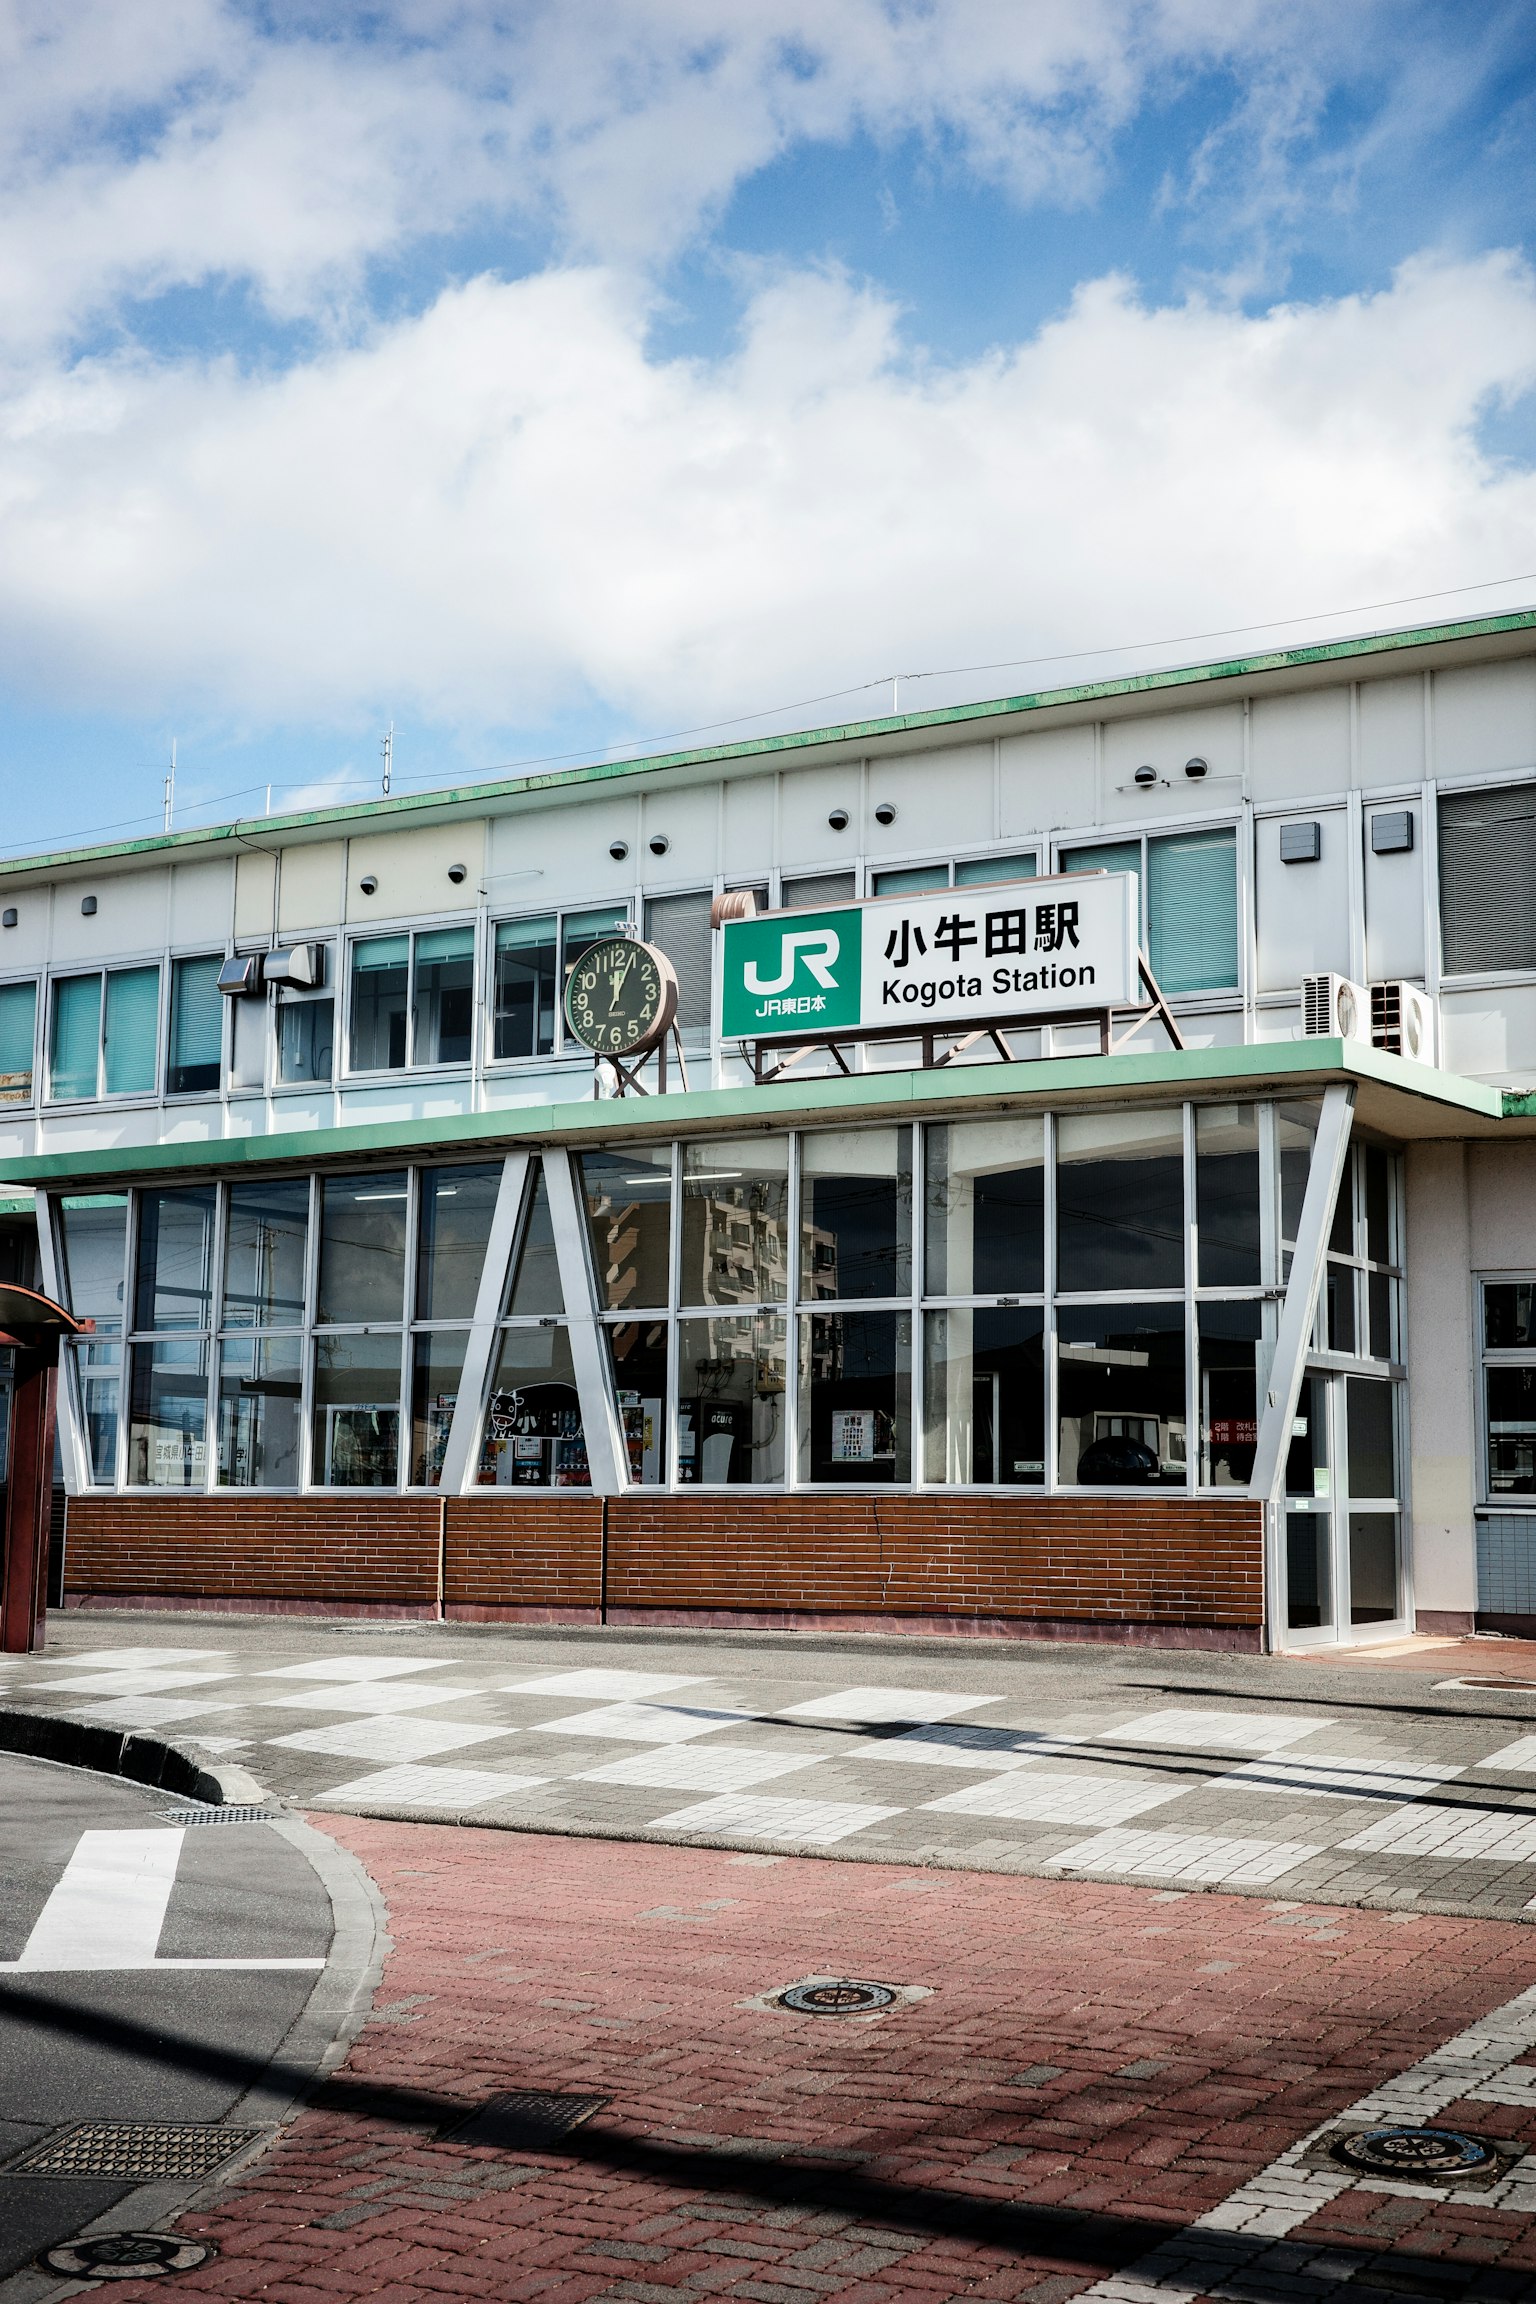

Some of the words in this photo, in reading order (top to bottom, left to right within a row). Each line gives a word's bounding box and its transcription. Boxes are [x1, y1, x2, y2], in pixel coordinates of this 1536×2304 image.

[884, 901, 1080, 968] 小牛田駅
[596, 955, 607, 973] 11
[611, 949, 626, 967] 12
[744, 928, 839, 995] JR
[582, 972, 597, 990] 10
[641, 963, 652, 981] 2
[645, 983, 657, 1000] 3
[882, 974, 982, 1008] Kogota
[992, 963, 1095, 994] Station
[577, 993, 588, 1010] 9
[755, 994, 826, 1018] JR東日本
[582, 1010, 594, 1028] 8
[640, 1003, 651, 1020] 4
[595, 1024, 606, 1041] 7
[610, 1027, 622, 1044] 6
[627, 1020, 639, 1037] 5
[711, 1414, 733, 1425] acure
